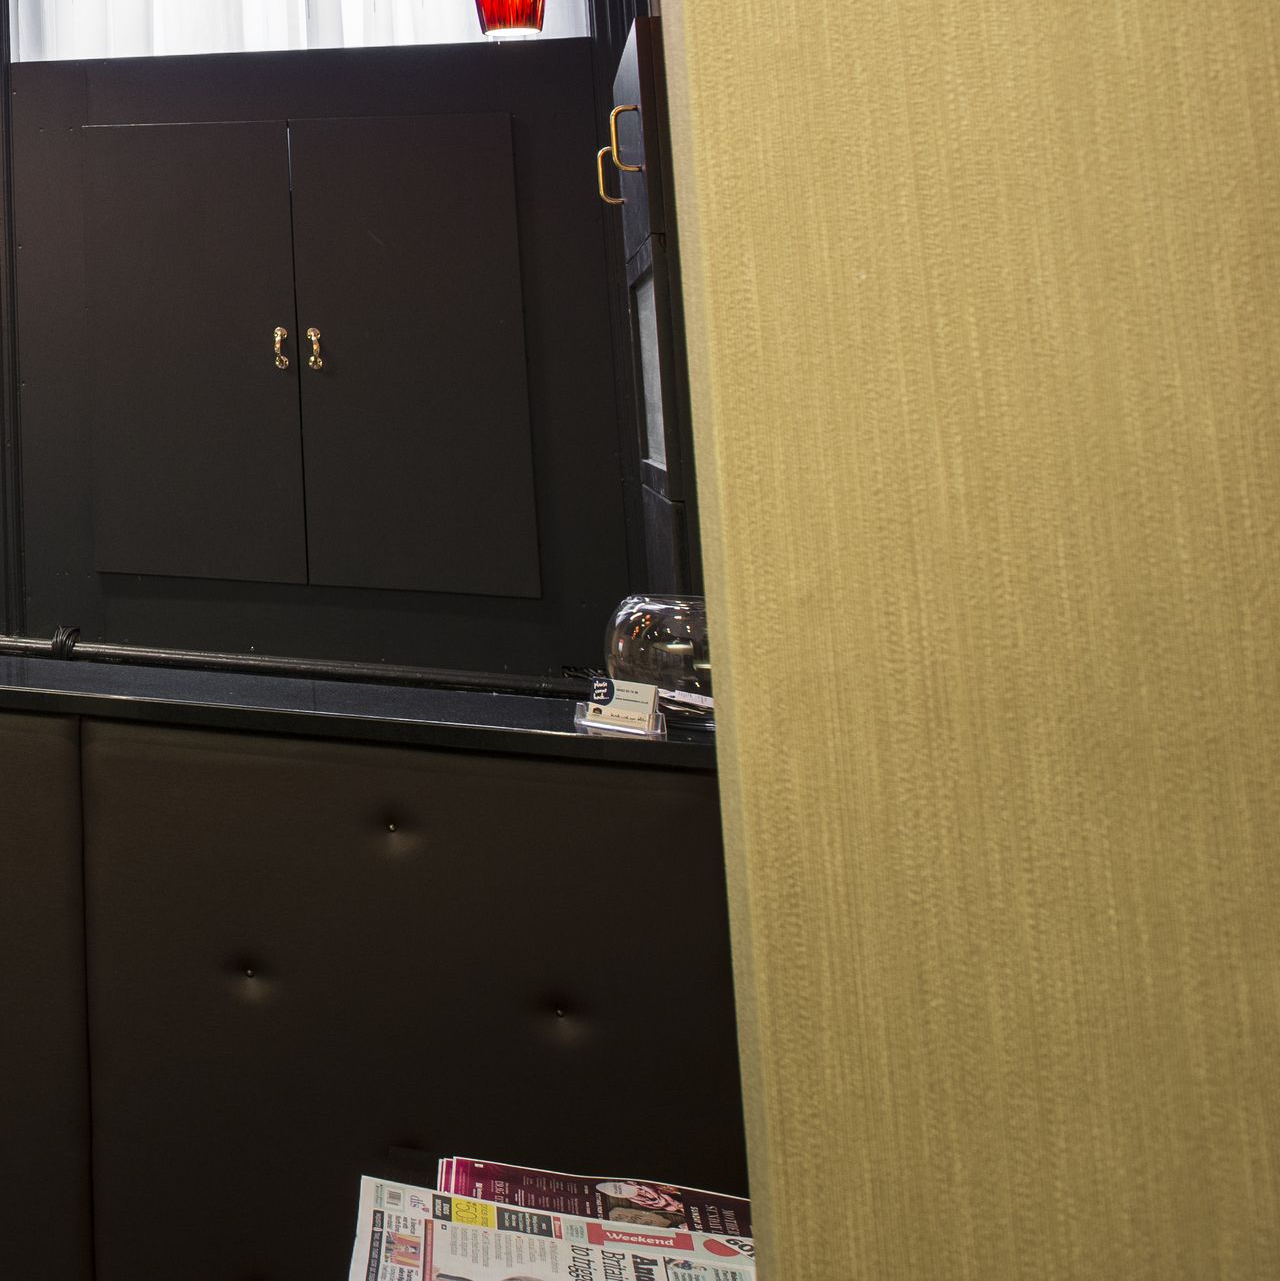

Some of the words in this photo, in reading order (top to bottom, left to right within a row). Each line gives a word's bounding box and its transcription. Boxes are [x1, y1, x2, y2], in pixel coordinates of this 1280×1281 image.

[411, 1194, 425, 1209] dfs
[606, 1231, 674, 1247] Weekend
[571, 1245, 594, 1257] to
